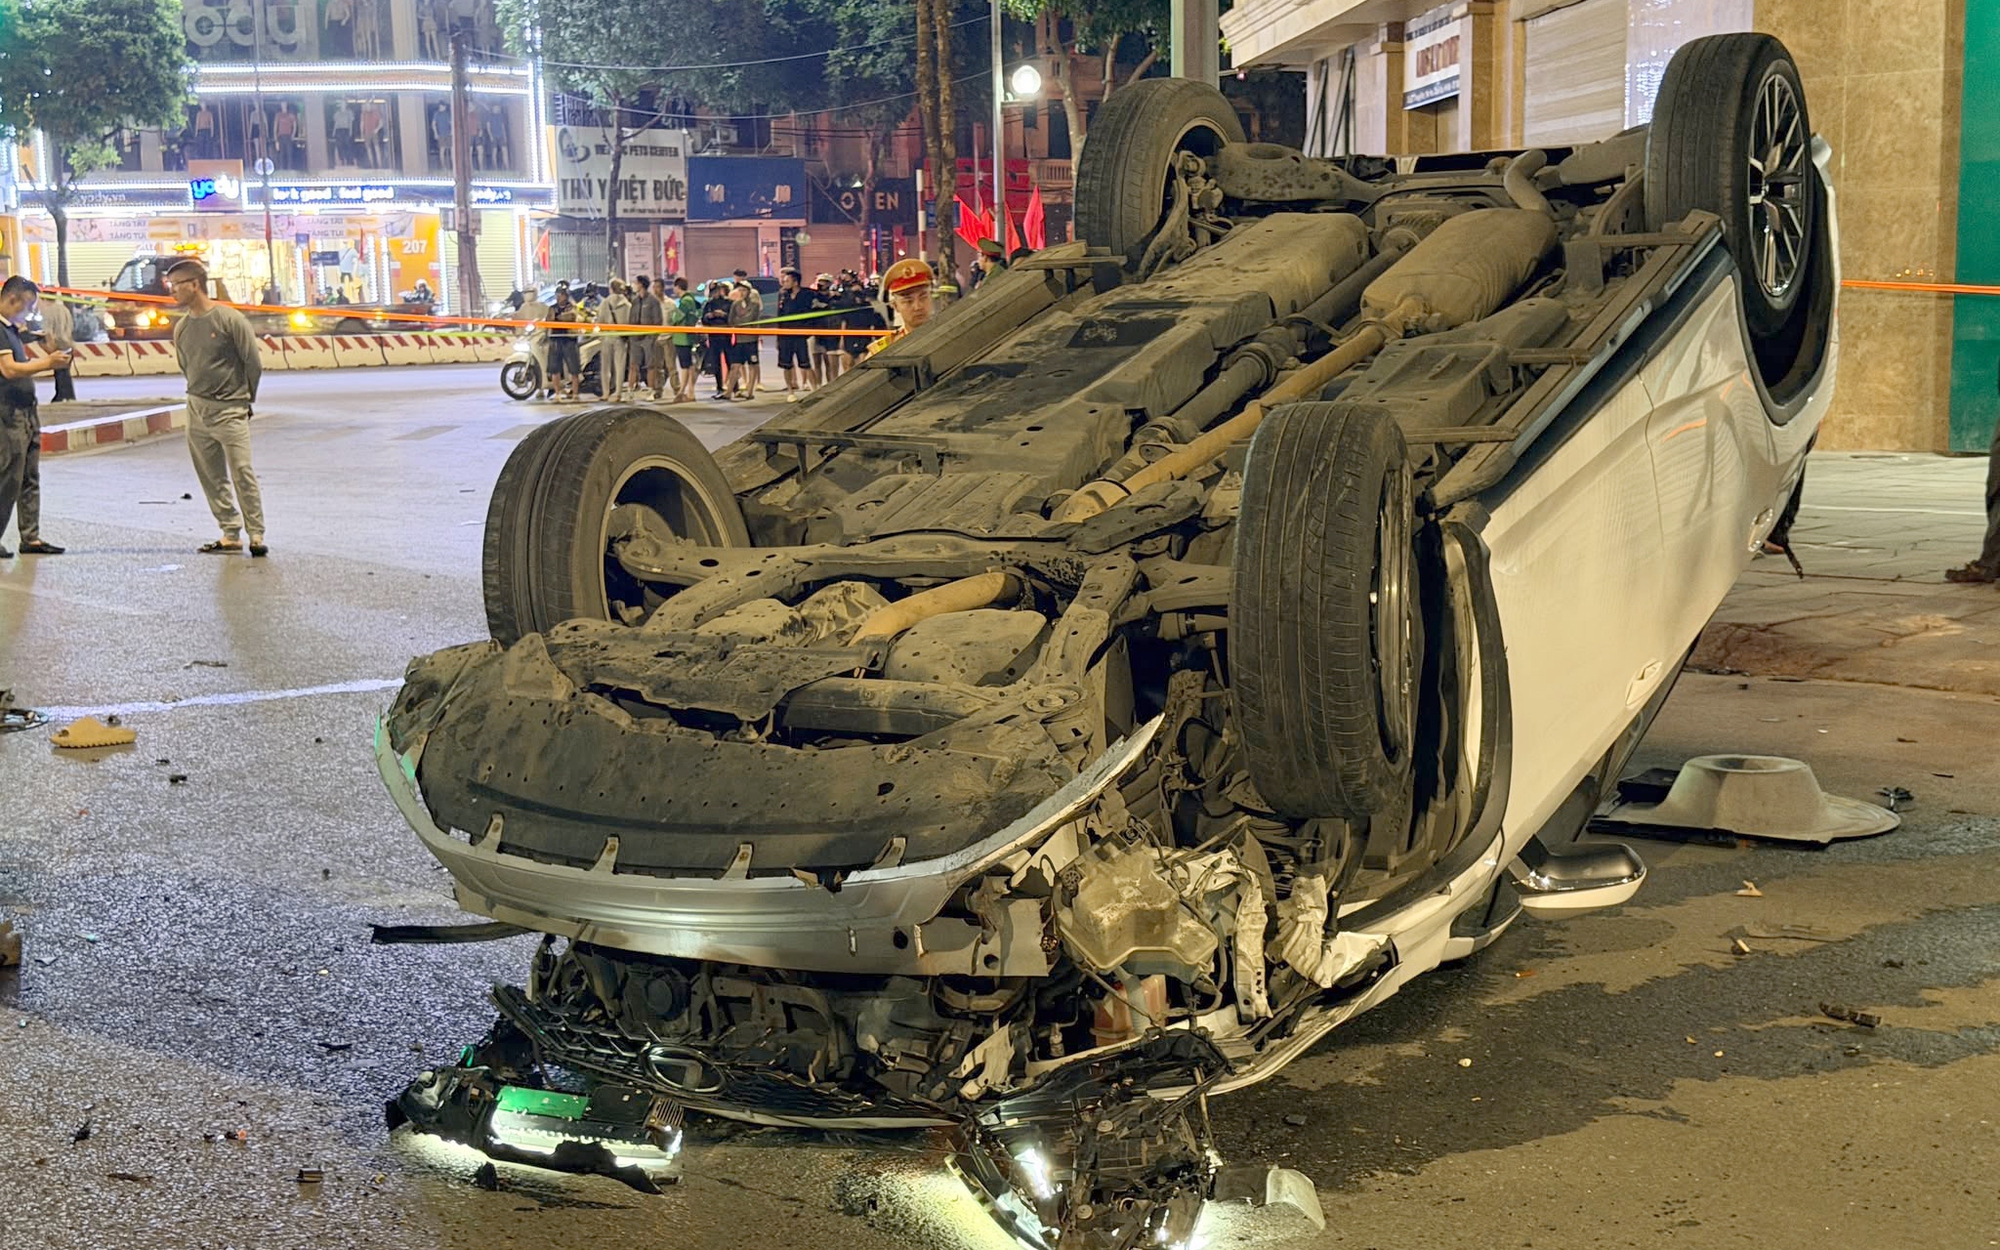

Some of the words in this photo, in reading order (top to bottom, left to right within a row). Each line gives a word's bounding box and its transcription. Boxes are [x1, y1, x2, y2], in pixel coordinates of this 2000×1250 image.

[182, 0, 308, 58] ody
[191, 177, 239, 199] yody
[561, 173, 593, 200] THÚ
[597, 178, 607, 200] Y
[402, 239, 428, 254] 207
